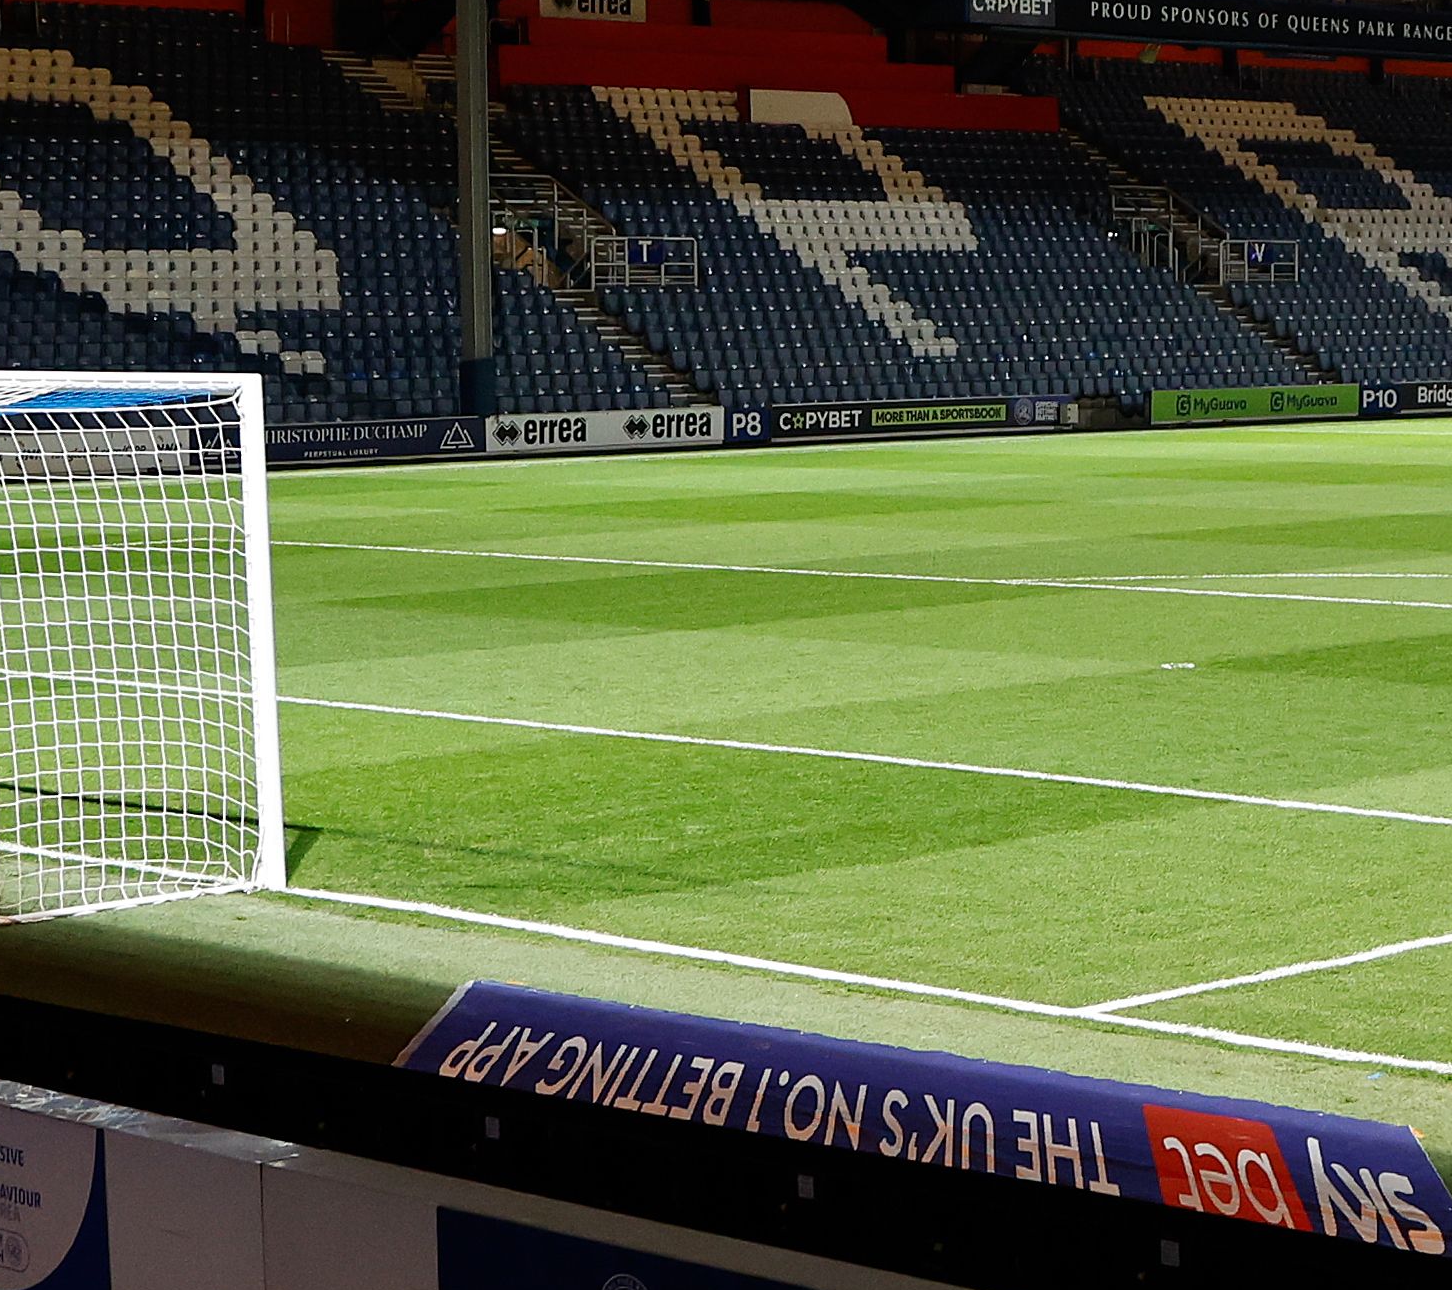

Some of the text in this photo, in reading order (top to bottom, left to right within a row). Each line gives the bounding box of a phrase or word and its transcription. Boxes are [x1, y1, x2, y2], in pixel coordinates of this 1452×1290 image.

[1090, 1, 1151, 21] PROUD
[1161, 6, 1249, 28] SPONSORS
[1258, 12, 1279, 29] OF
[1287, 14, 1349, 35] QUEENS
[1358, 20, 1395, 38] PARK
[638, 241, 652, 263] T
[1254, 243, 1265, 263] V
[876, 411, 903, 424] MORE
[906, 409, 929, 422] THAN
[932, 409, 938, 420] A
[940, 407, 1001, 421] SPORTSBOOK
[1362, 389, 1396, 408] P10
[354, 422, 427, 441] DUCHAMP
[733, 412, 762, 437] P8
[439, 1022, 555, 1086] APP
[535, 1036, 745, 1126] BETTING
[879, 1089, 994, 1174] UK'S
[1012, 1110, 1121, 1197] THE
[1163, 1136, 1293, 1230] bet
[1306, 1137, 1445, 1255] sky
